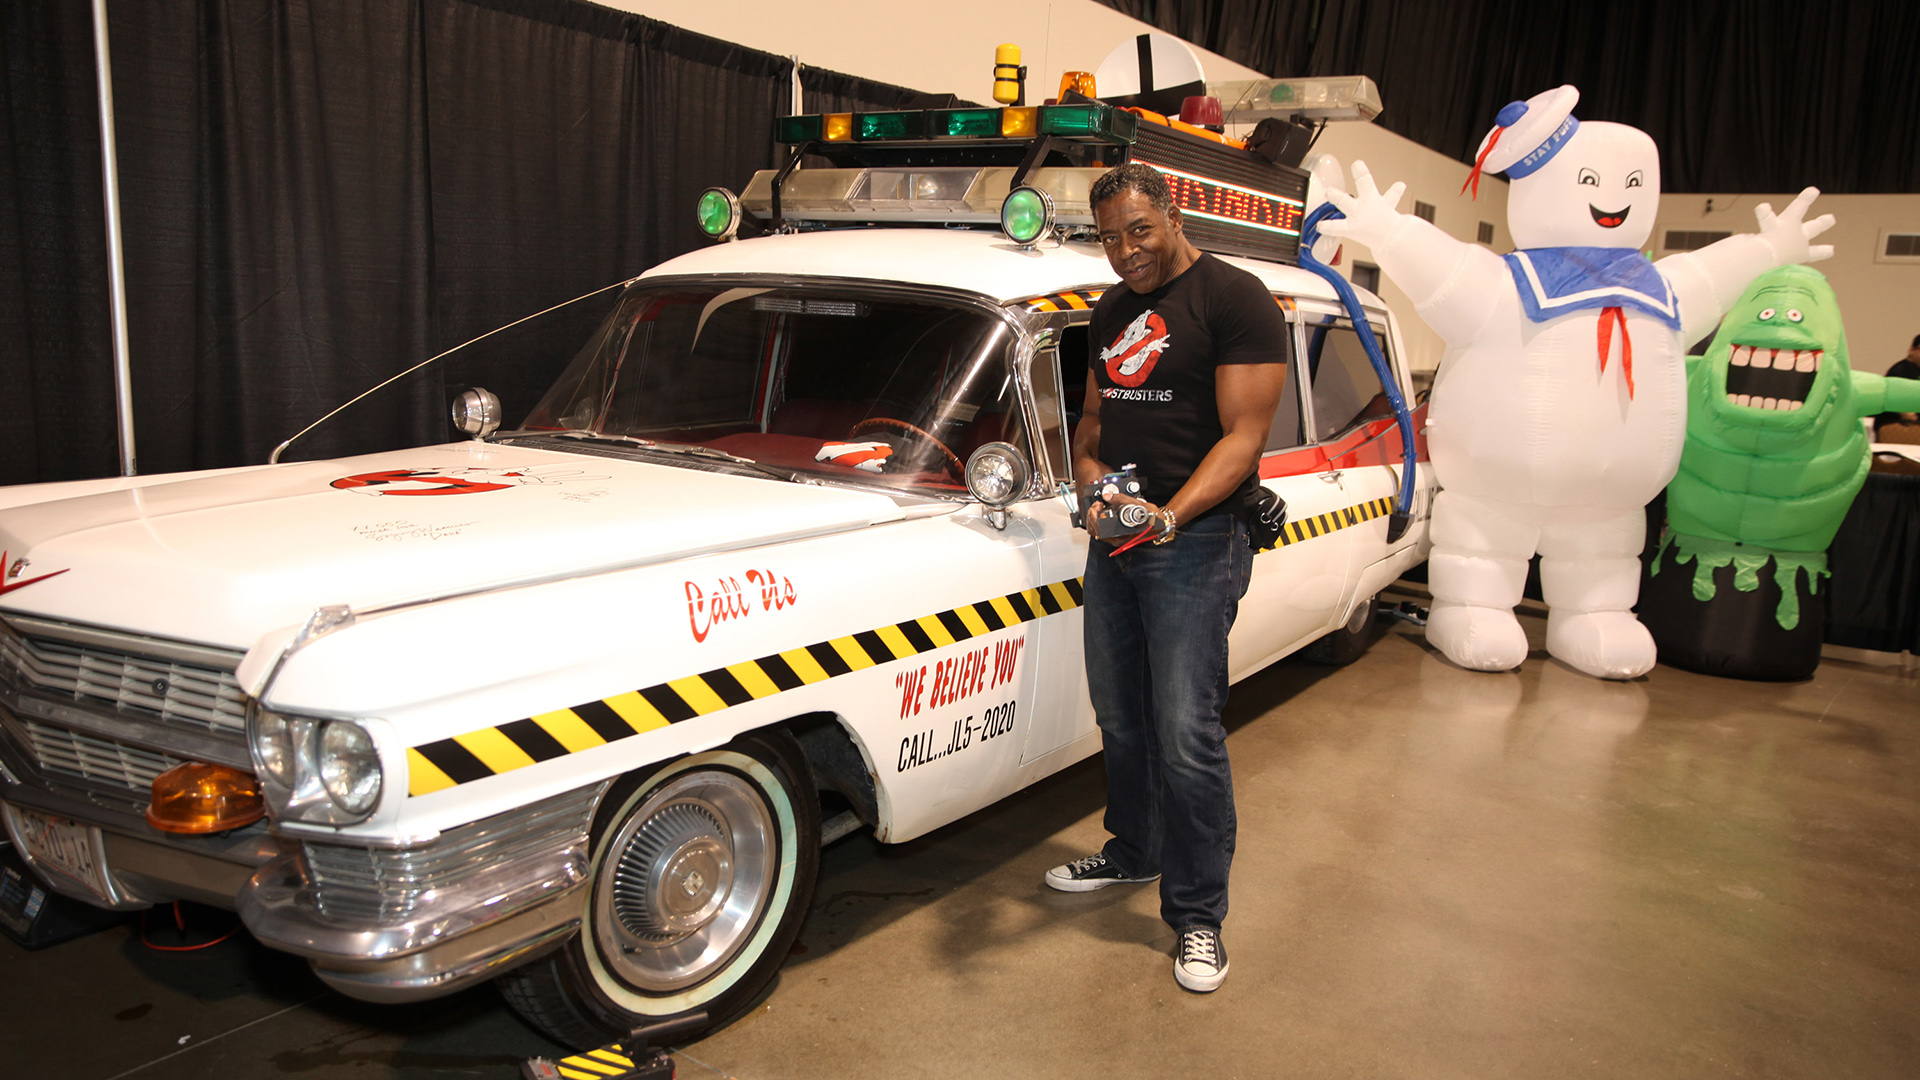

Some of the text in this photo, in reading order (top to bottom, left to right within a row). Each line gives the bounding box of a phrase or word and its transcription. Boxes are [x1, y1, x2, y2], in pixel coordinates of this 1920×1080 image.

[1523, 141, 1551, 167] STAY
[685, 569, 797, 643] Call Us
[896, 634, 1025, 720] "WE BELIEVE YOU"
